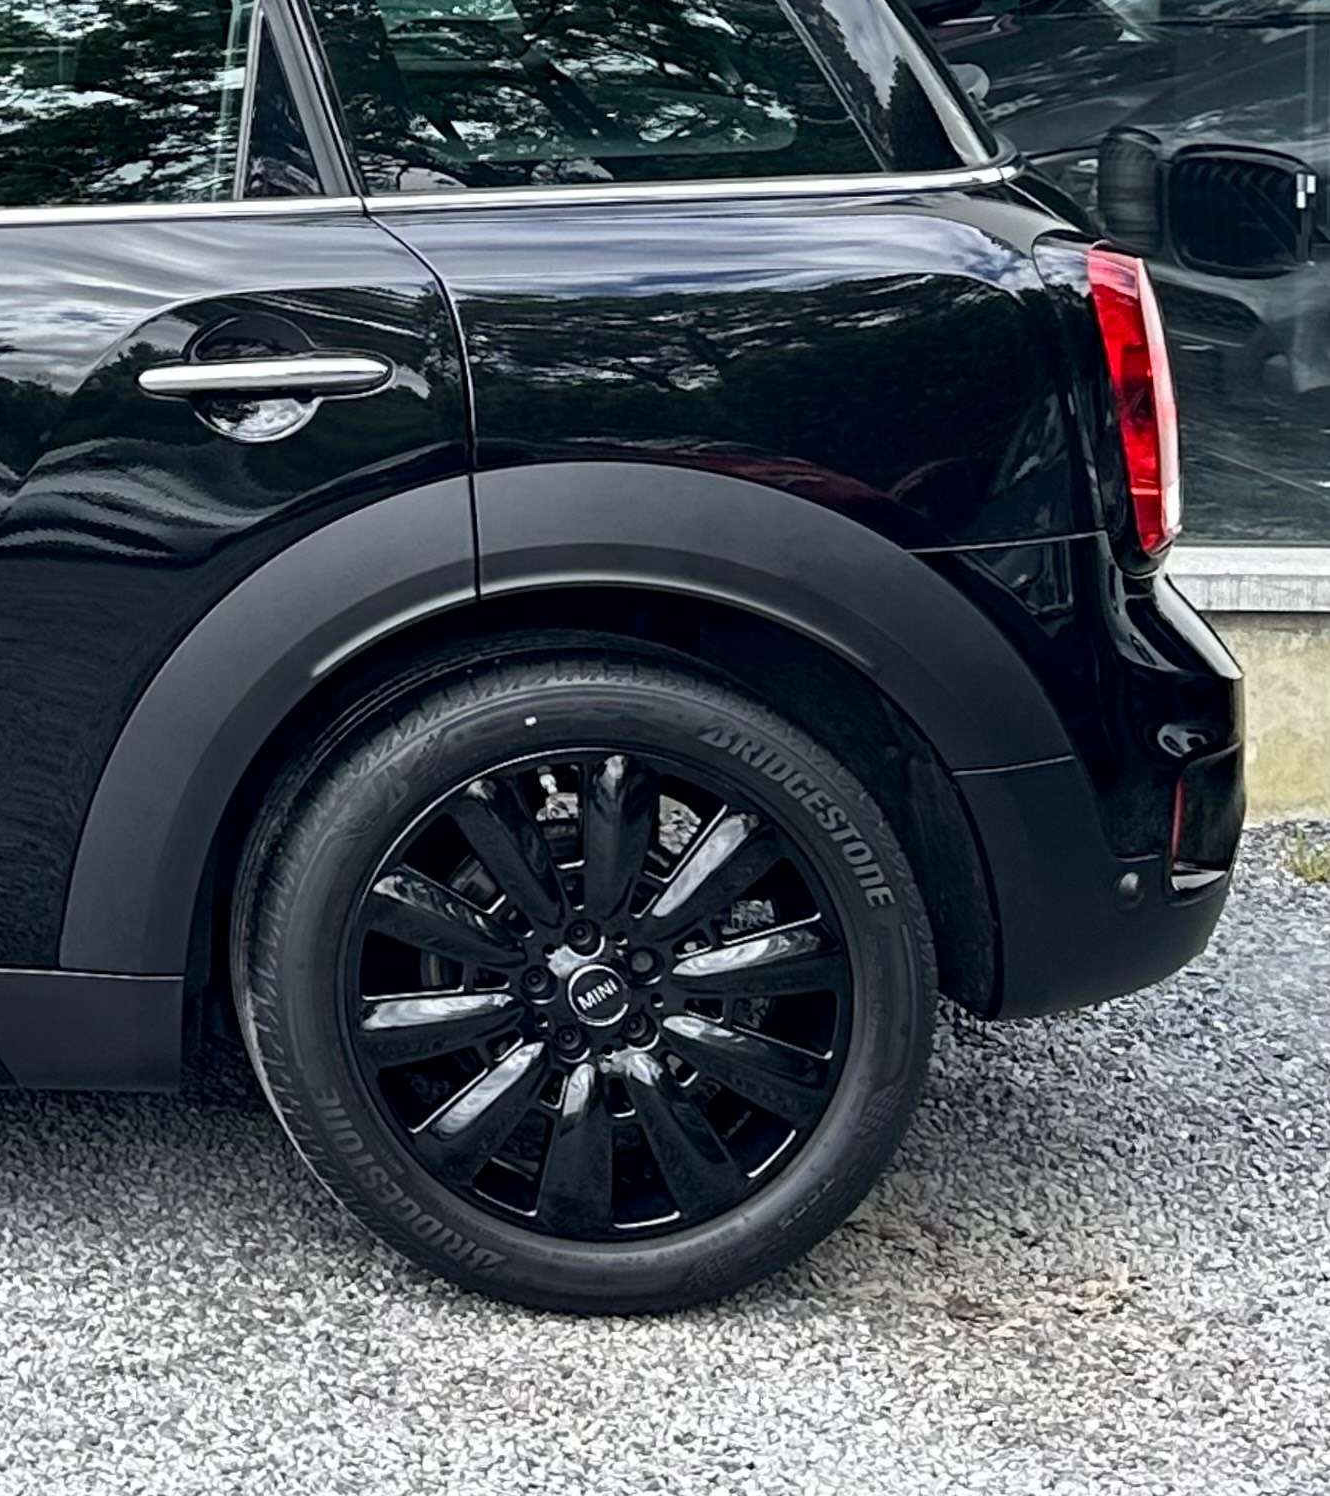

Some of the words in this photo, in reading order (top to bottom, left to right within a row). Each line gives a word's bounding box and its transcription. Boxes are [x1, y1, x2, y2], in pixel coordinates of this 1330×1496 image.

[698, 723, 895, 907] BRIDGESTONE
[577, 978, 619, 1011] MINI
[310, 1087, 507, 1271] BRIDGESTONE
